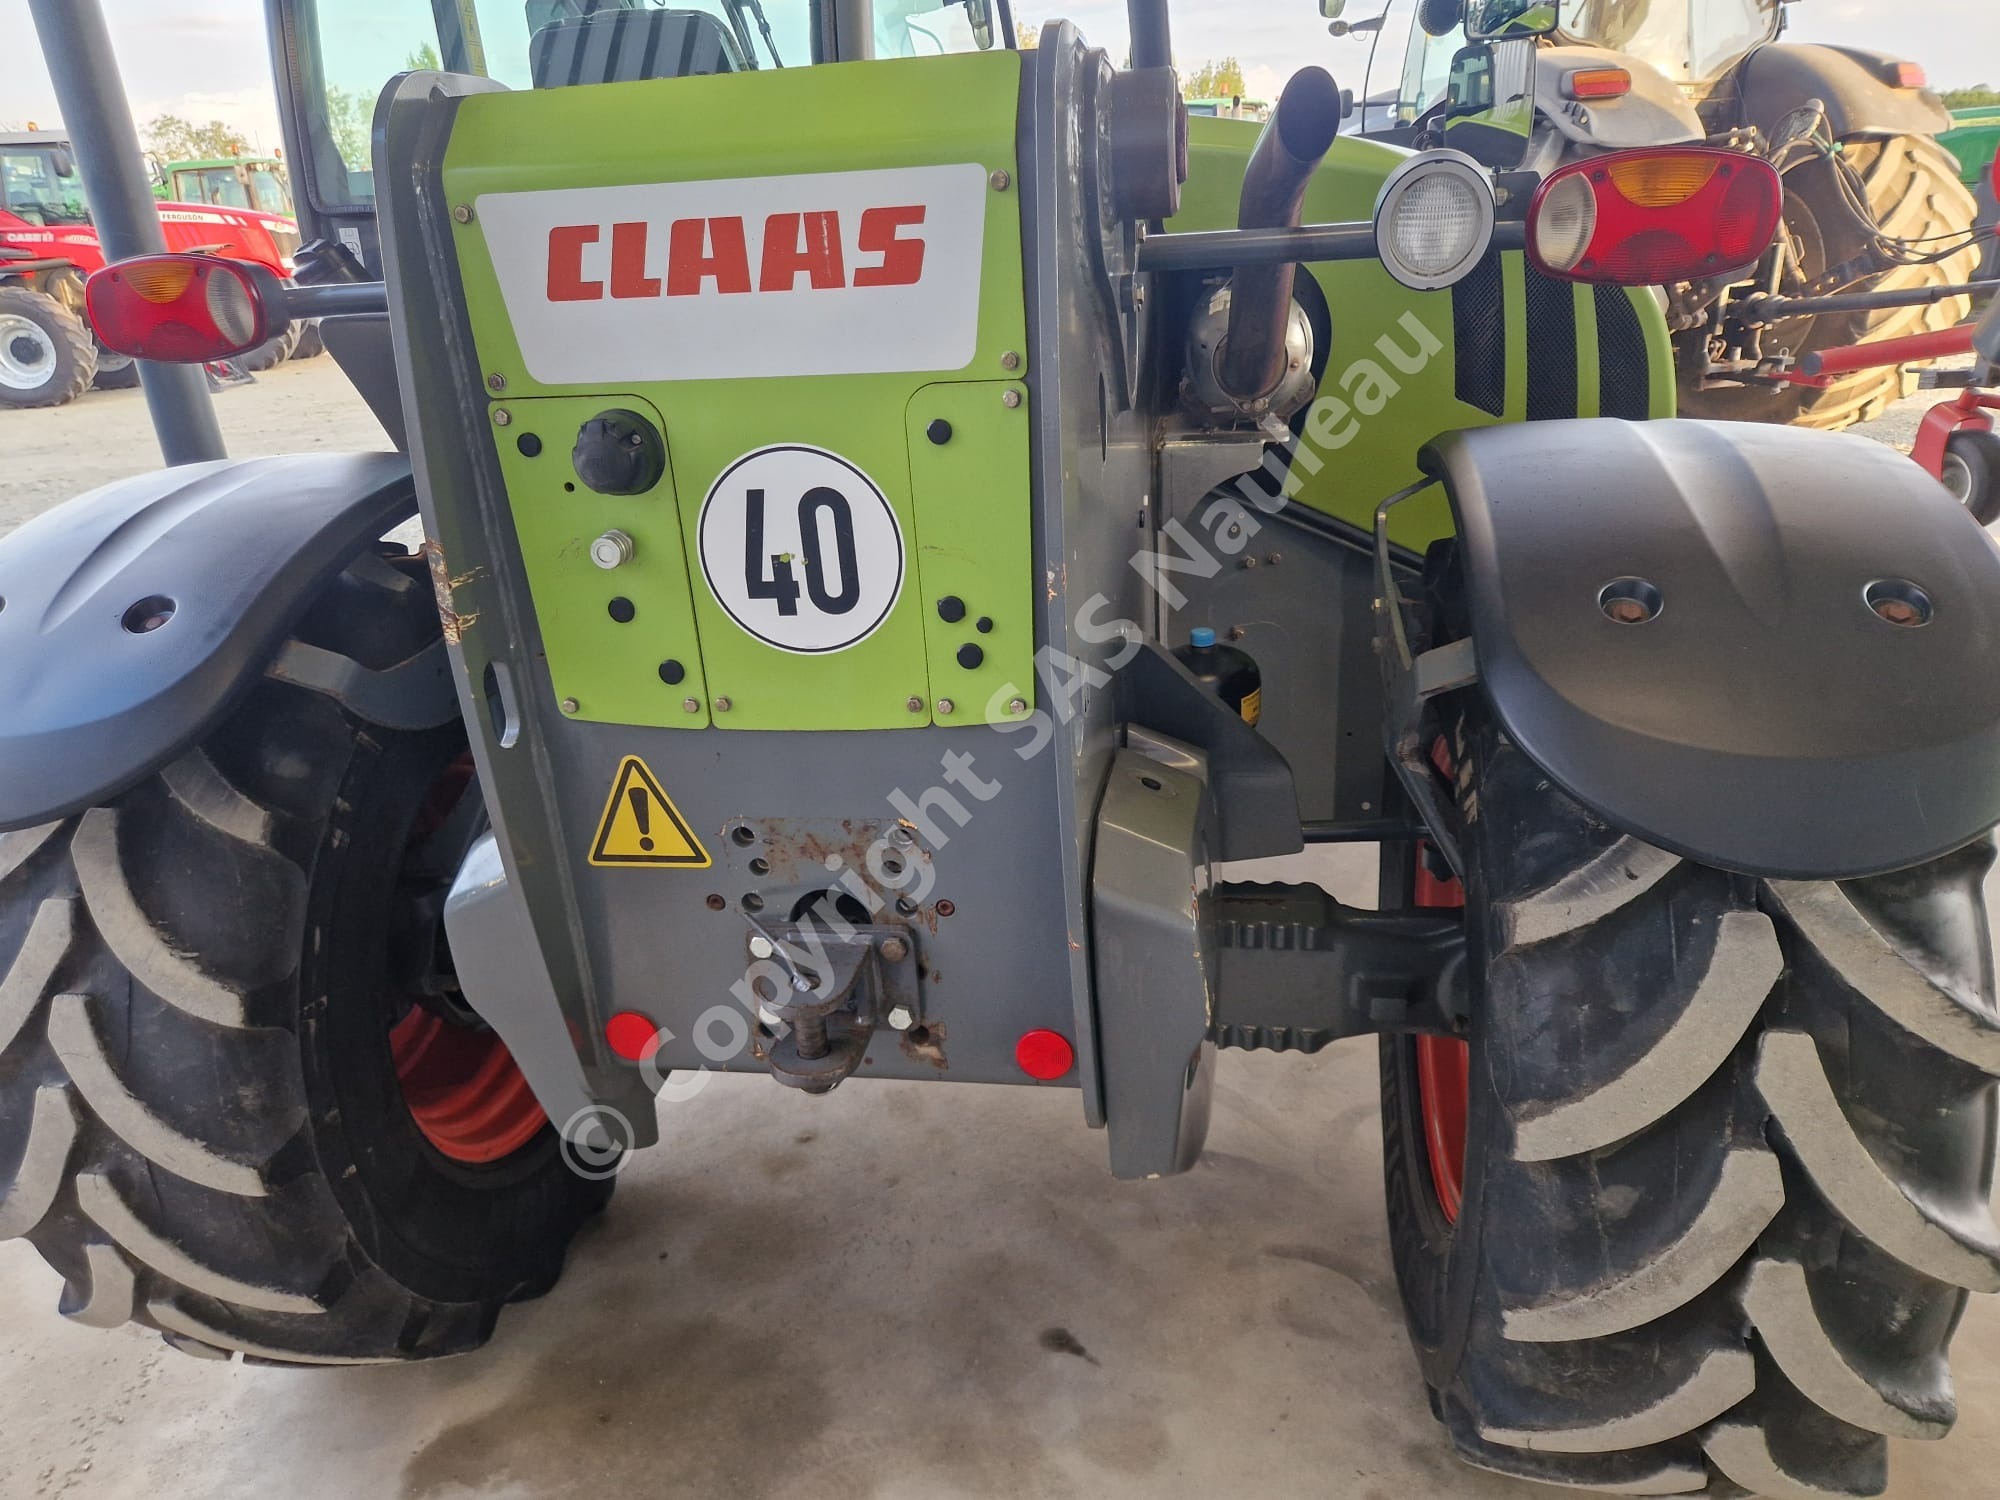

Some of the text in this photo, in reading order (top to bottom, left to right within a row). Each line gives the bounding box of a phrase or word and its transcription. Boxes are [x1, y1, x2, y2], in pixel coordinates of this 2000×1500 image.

[162, 213, 204, 221] FERGUSON
[547, 205, 926, 302] CLAAS
[745, 486, 861, 616] 40
